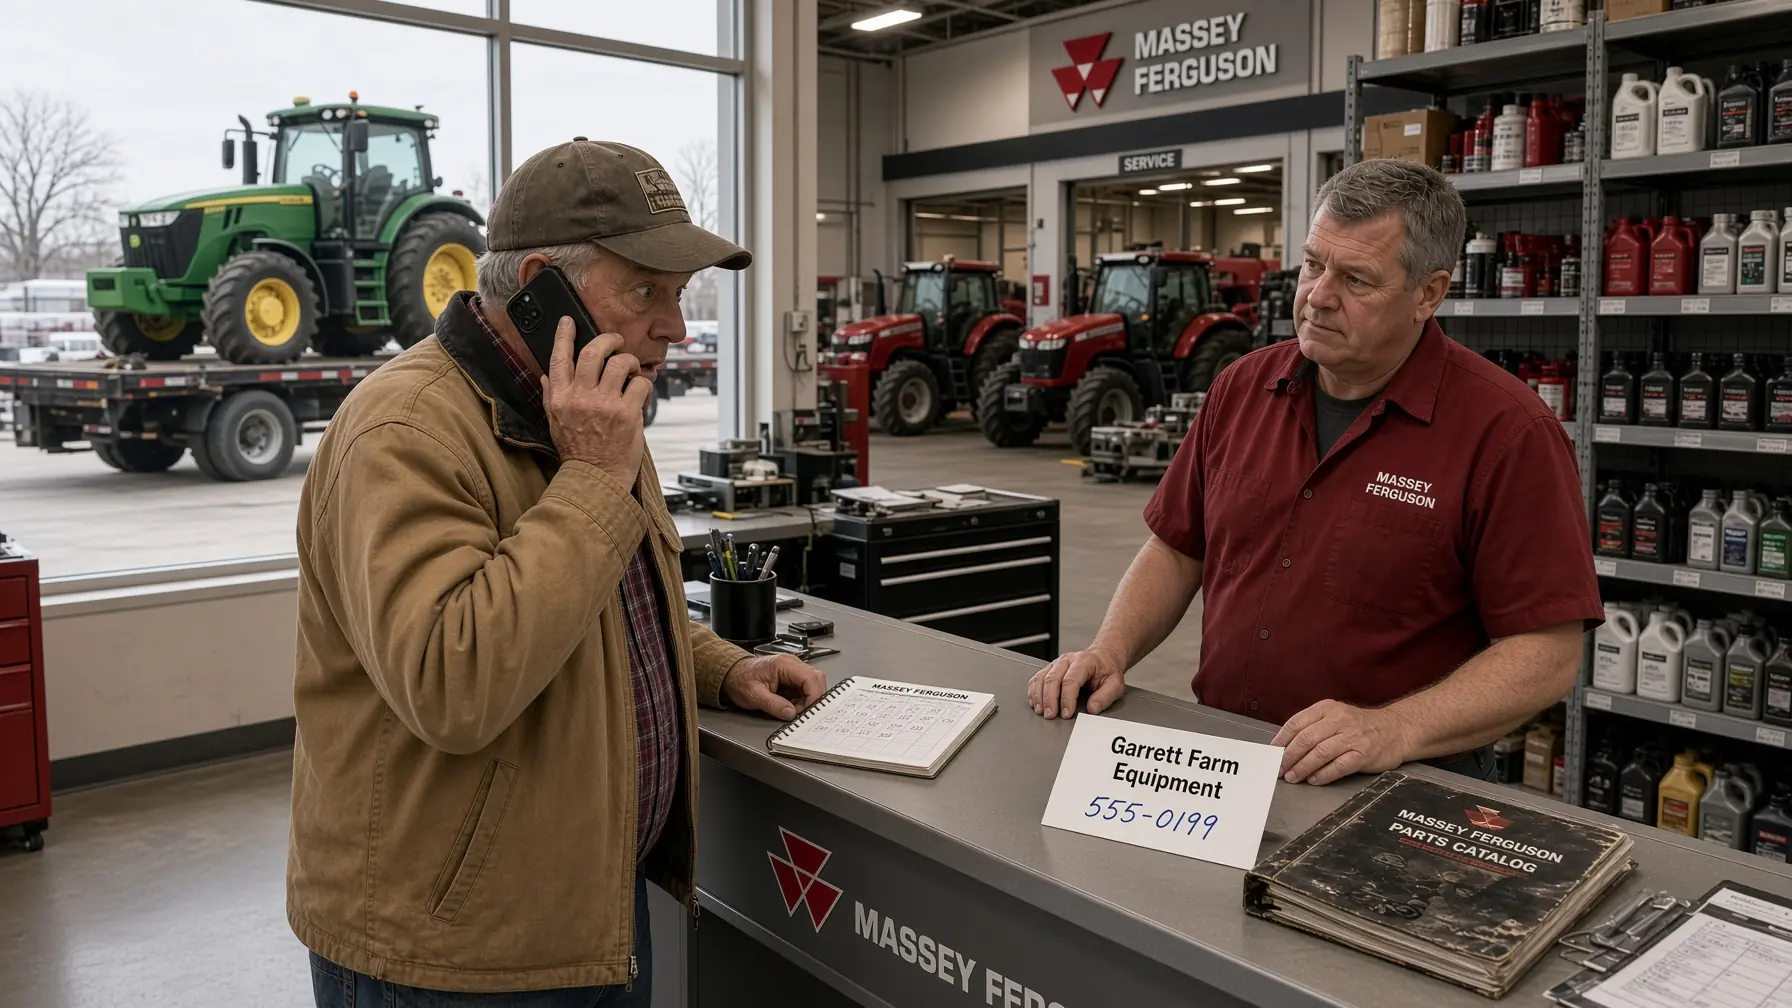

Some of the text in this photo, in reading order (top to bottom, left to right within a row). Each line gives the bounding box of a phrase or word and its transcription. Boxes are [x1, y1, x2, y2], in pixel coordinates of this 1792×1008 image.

[1134, 12, 1247, 60] MASSEY
[1134, 44, 1278, 96] FERGUSON
[1124, 152, 1175, 172] SERVICE
[1365, 483, 1436, 509] FERGUSON
[1376, 471, 1433, 494] MASSEY
[871, 683, 969, 700] MASSEY FERGUSON
[1111, 735, 1240, 776] Garrett Farm
[1112, 762, 1224, 800] Equipment
[1084, 796, 1219, 840] 555-0199
[1397, 808, 1565, 864] MASSEY FERGUSON
[1388, 821, 1539, 874] PARTS CATALOG
[854, 900, 1066, 1008] MASSEY FER
